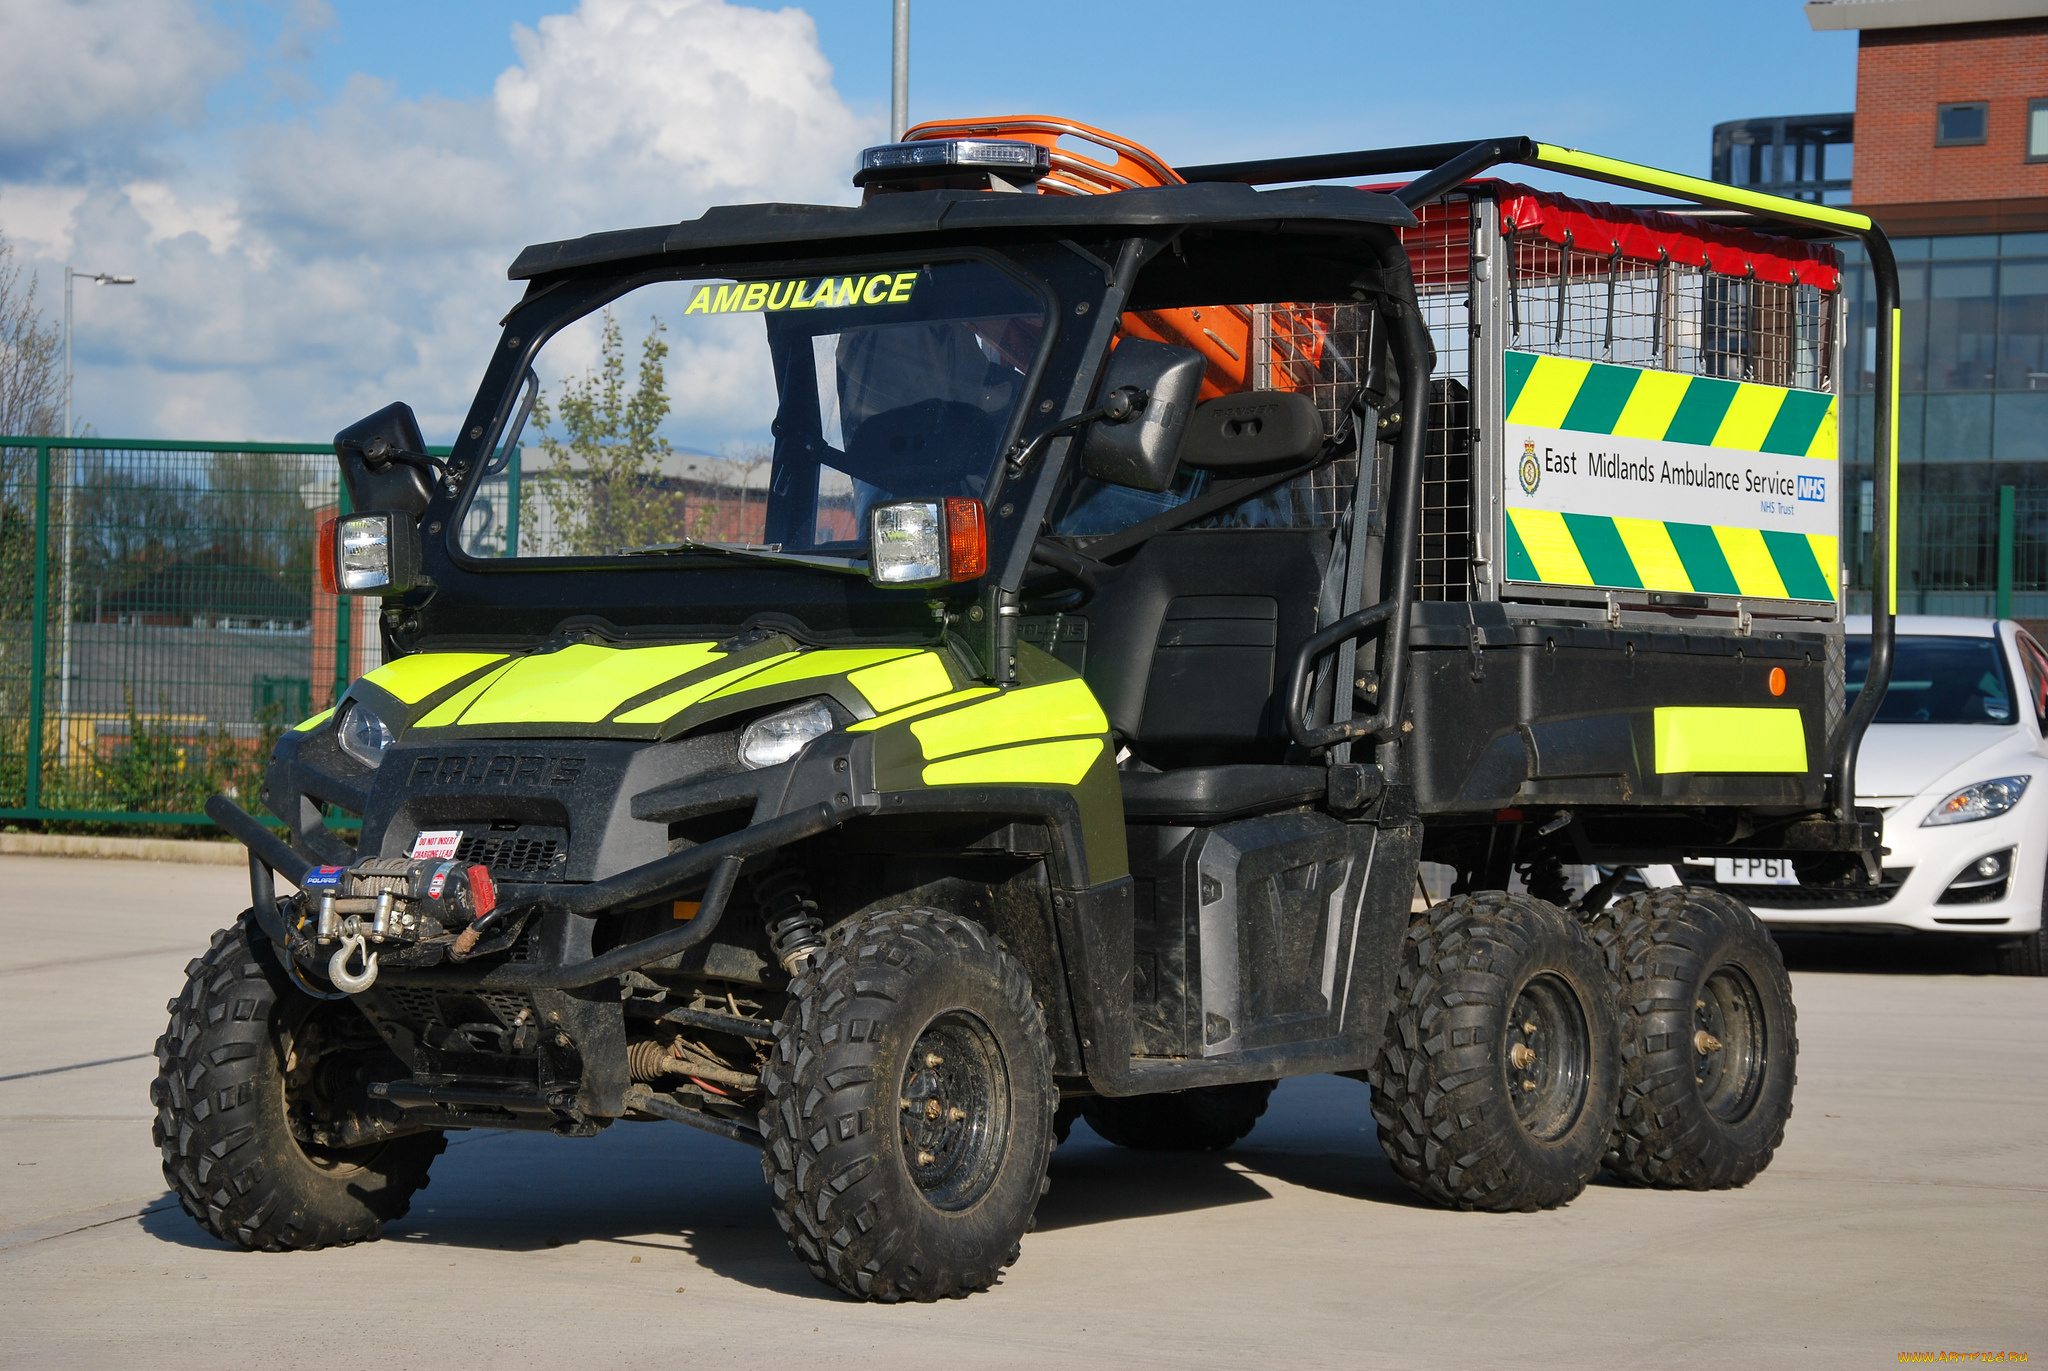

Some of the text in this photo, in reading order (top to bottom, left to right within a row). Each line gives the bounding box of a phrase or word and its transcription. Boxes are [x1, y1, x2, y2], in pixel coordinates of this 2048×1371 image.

[684, 272, 918, 315] AMBULANCE
[1209, 403, 1279, 418] RANGER
[1545, 447, 1794, 497] East Midlands Ambulance Service
[1798, 476, 1825, 502] NHS
[1760, 501, 1795, 516] NHS Trust
[405, 755, 586, 787] POLARIS
[418, 836, 458, 846] DO NOT INSERT
[413, 849, 454, 859] CHARGING LEAD
